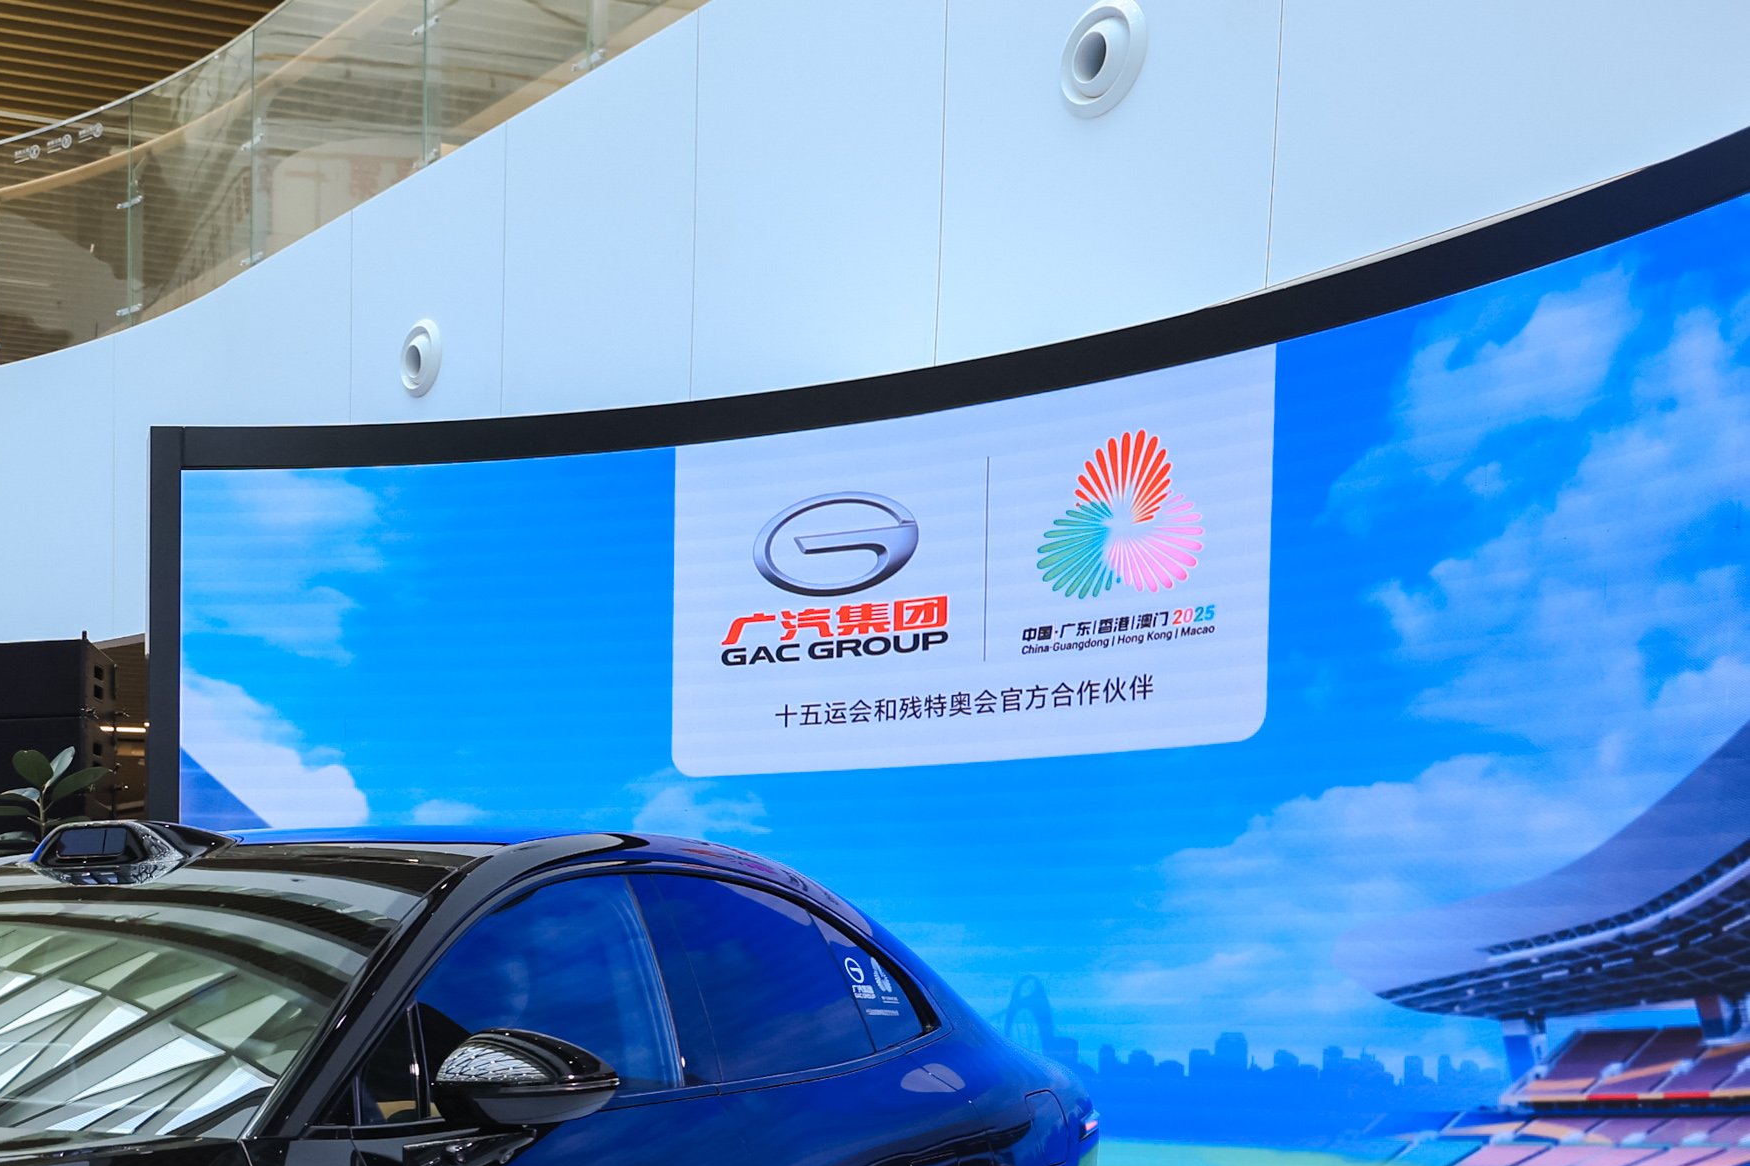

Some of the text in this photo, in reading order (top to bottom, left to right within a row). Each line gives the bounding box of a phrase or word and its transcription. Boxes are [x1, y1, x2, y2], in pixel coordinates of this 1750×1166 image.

[720, 595, 949, 646] 广汽集团
[1117, 630, 1145, 645] Hong
[1146, 626, 1174, 642] Kong
[1180, 623, 1216, 638] Macao
[1171, 604, 1216, 626] 2025
[720, 629, 950, 667] GAC GROUP
[774, 673, 1155, 729] 十五运会和残特奥会官方合作伙伴
